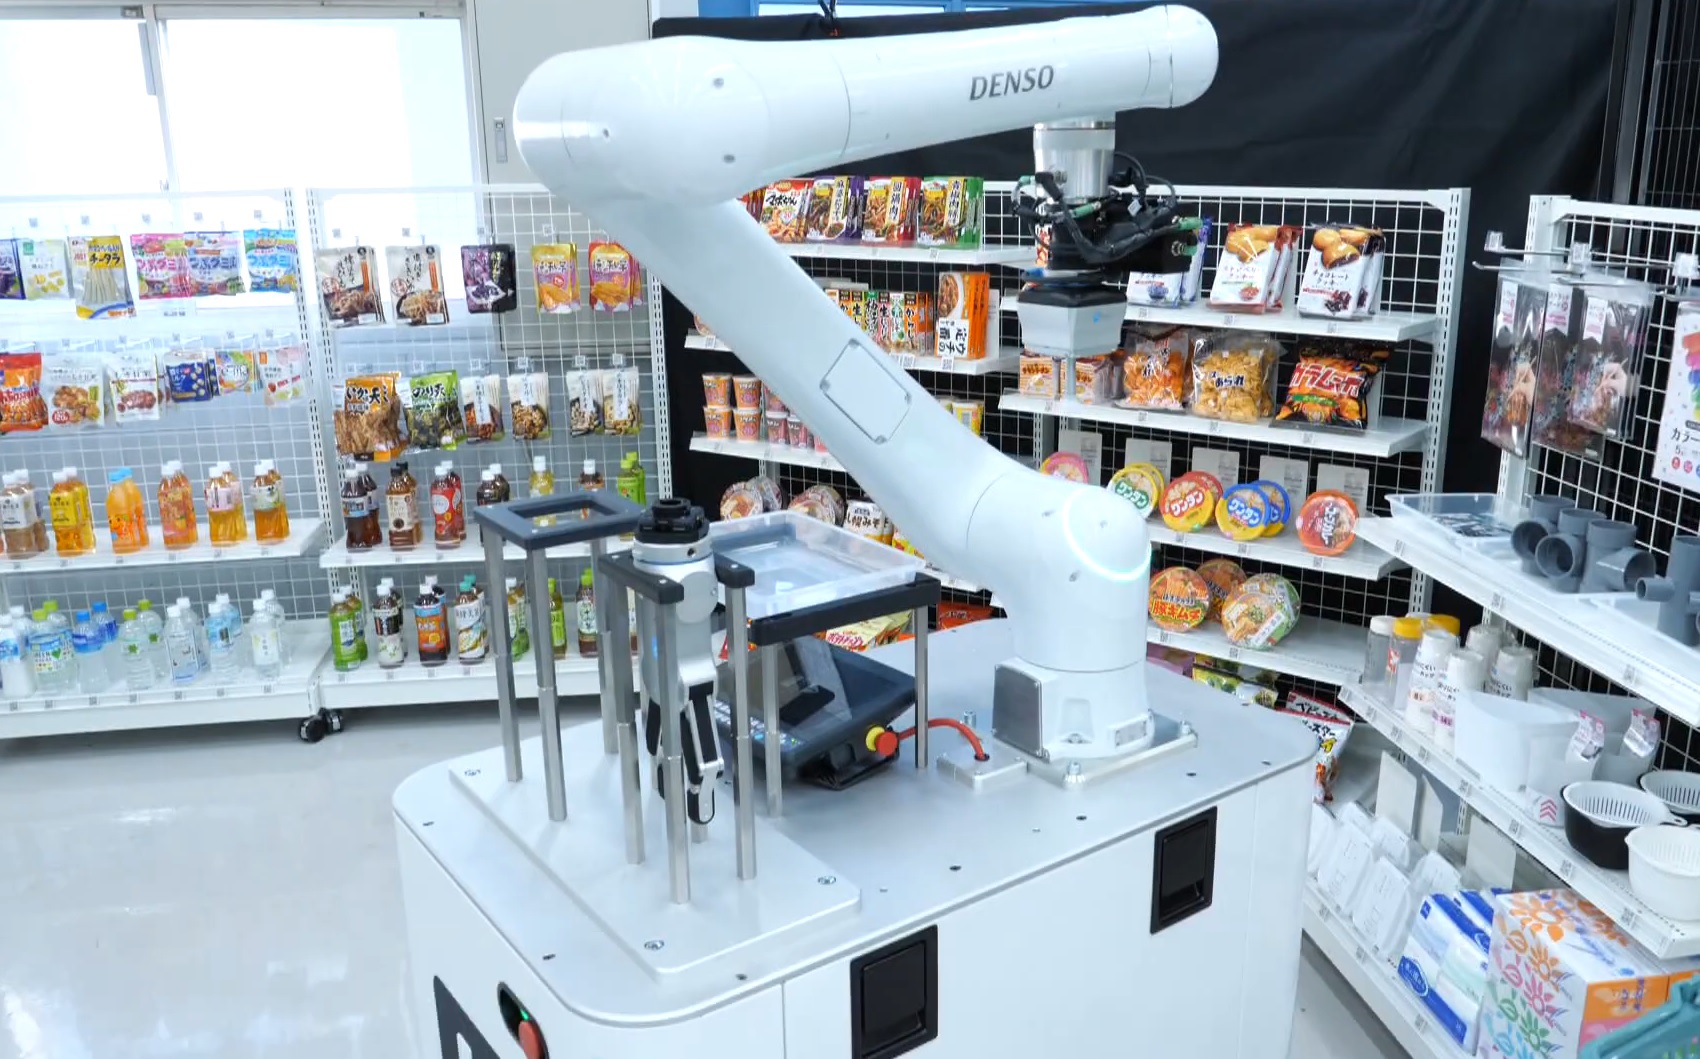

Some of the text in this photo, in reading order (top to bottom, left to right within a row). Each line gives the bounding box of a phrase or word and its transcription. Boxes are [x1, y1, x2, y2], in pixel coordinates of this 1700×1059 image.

[969, 64, 1054, 101] DENSO
[412, 382, 446, 398] のり天
[1671, 427, 1700, 443] カラー
[1115, 480, 1149, 510] ワンタン
[1170, 490, 1204, 518] ワンタン
[1228, 498, 1260, 526] ワンタン
